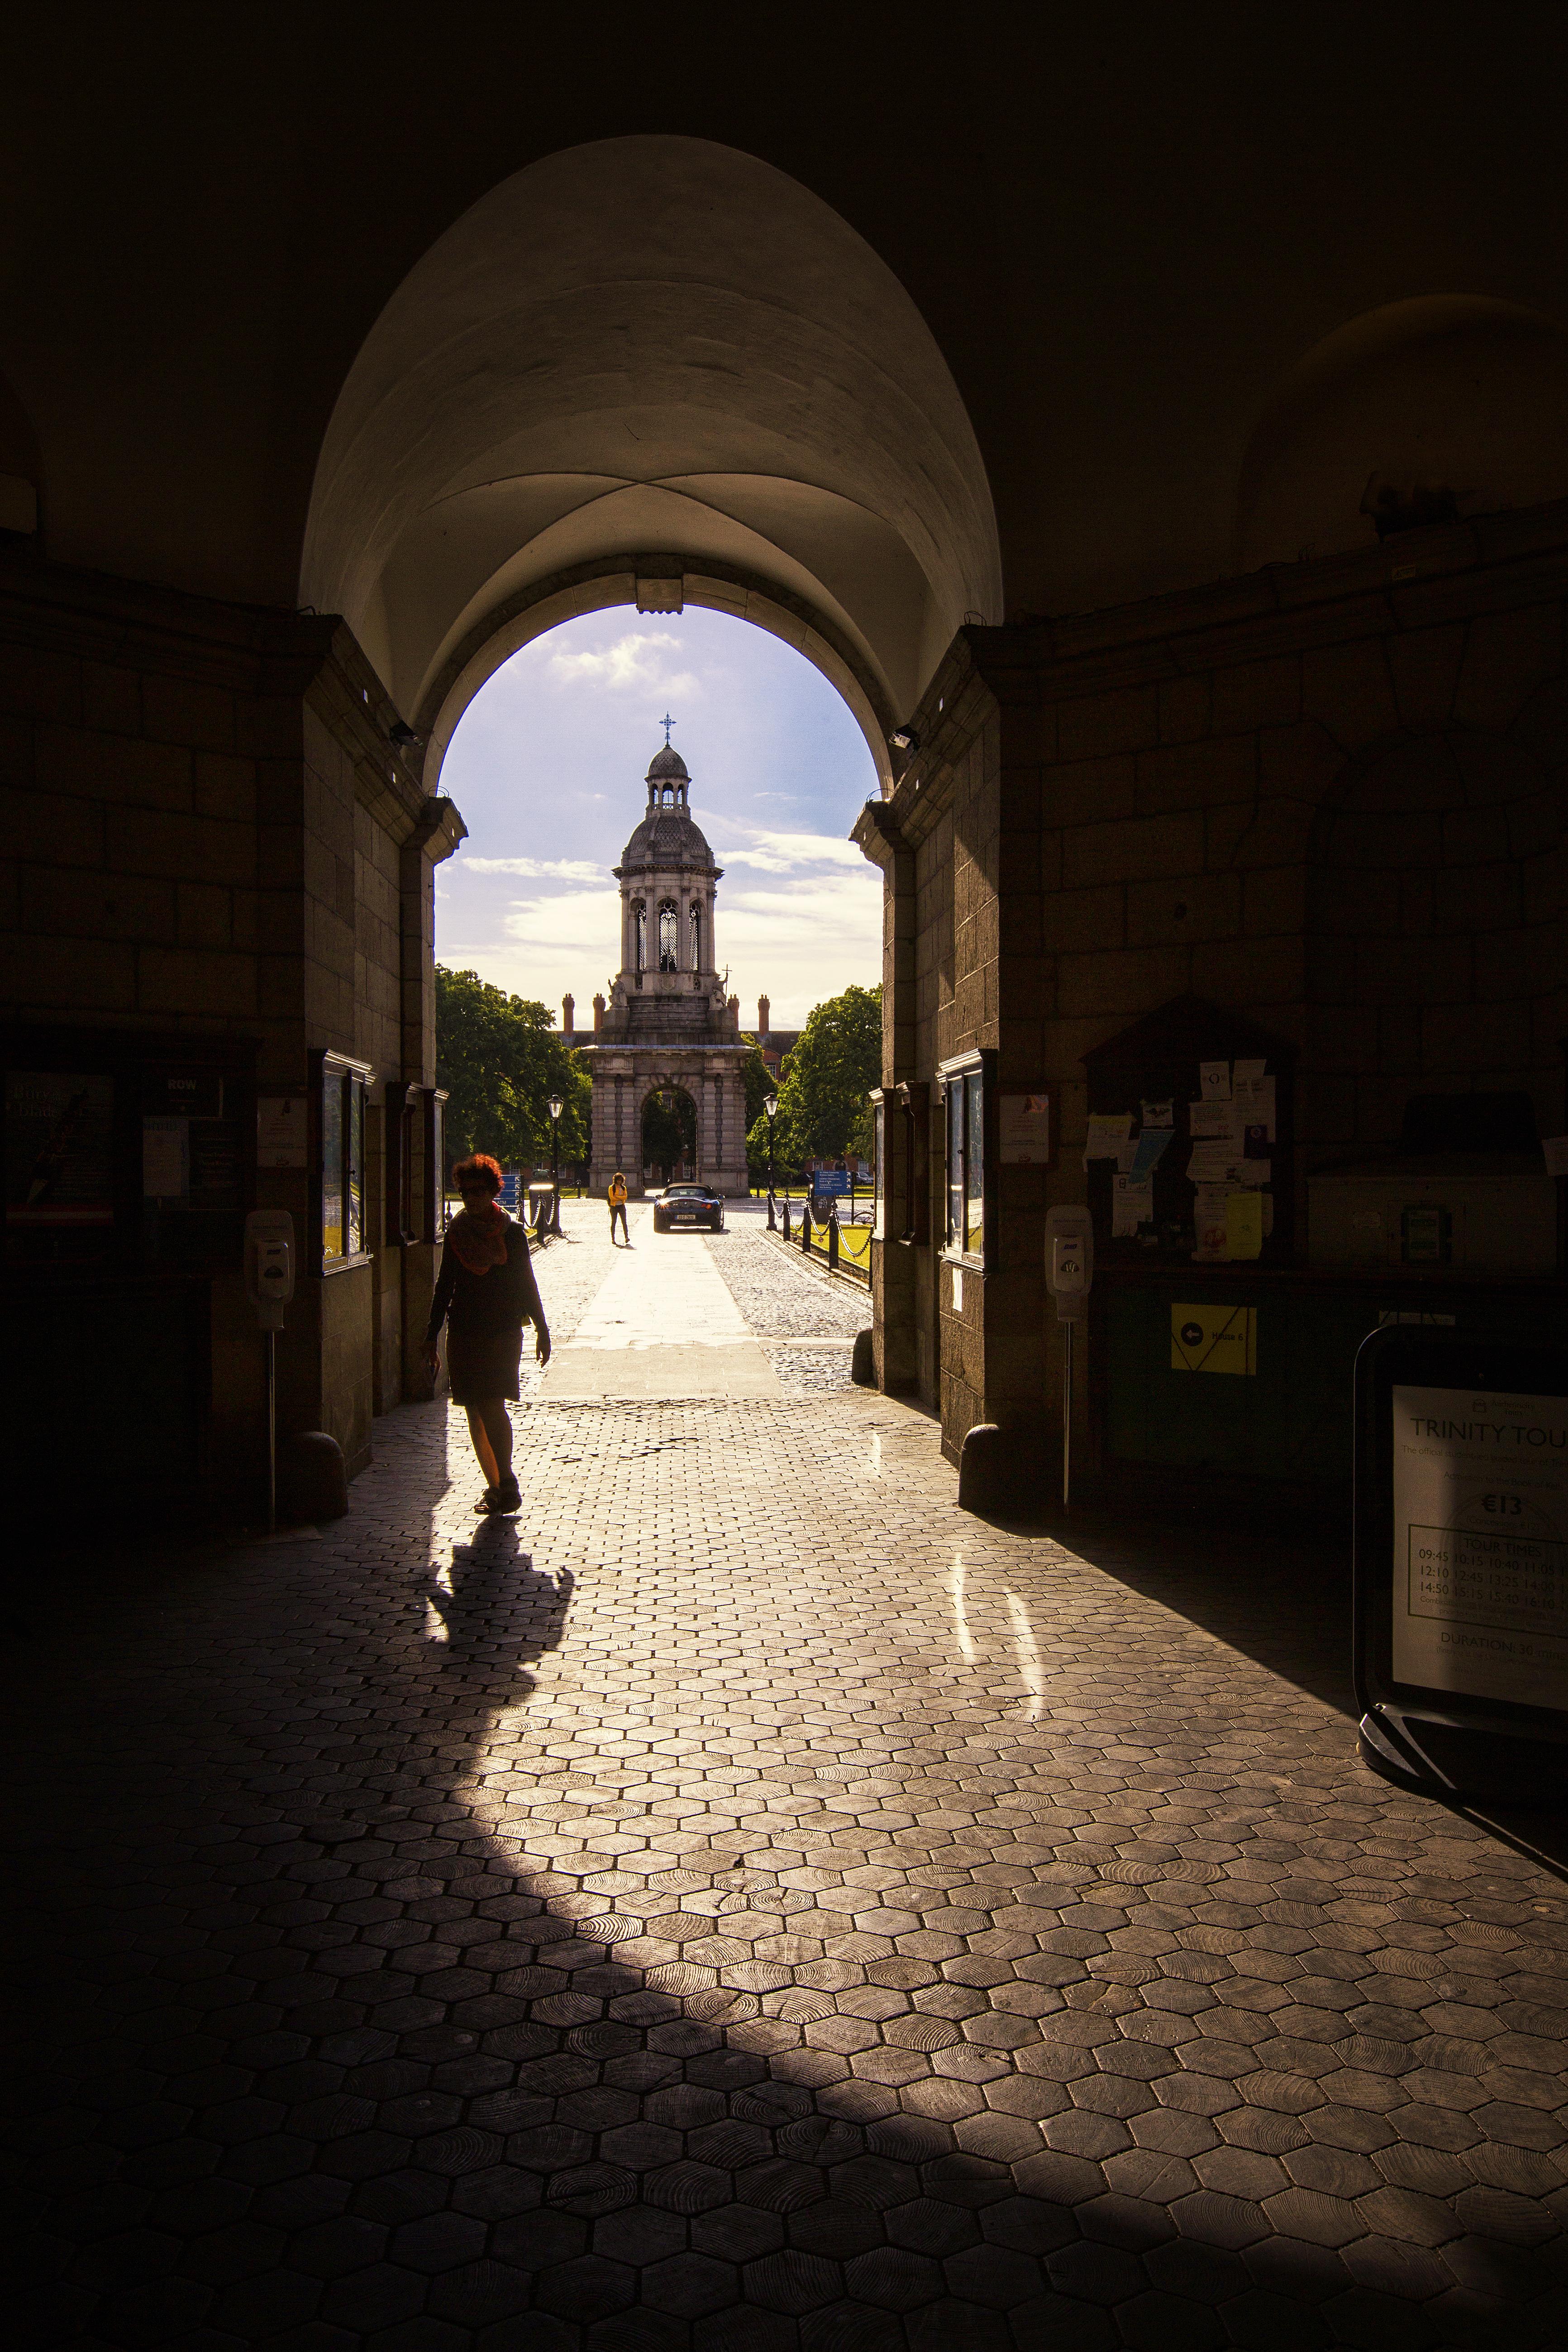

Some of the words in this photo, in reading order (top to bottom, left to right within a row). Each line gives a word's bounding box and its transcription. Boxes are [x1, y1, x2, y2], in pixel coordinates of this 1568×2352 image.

[1212, 1332, 1236, 1341] House
[1411, 1418, 1506, 1443] TRINITY
[1402, 1446, 1416, 1454] The
[1418, 1447, 1443, 1456] official
[1444, 1471, 1483, 1483] Admission
[1495, 1477, 1509, 1485] the
[1511, 1478, 1532, 1488] Book
[1535, 1480, 1546, 1489] of
[1481, 1493, 1522, 1516] €13
[1465, 1538, 1501, 1553] TOUR
[1503, 1543, 1541, 1557] TIMES
[1419, 1549, 1449, 1562] 09:45
[1455, 1554, 1484, 1567] 10:15
[1489, 1558, 1519, 1571] 10:40
[1525, 1563, 1555, 1576] 11:05
[1420, 1565, 1449, 1579] 12:10
[1455, 1570, 1484, 1583] 12:45
[1489, 1574, 1519, 1588] 13:25
[1525, 1579, 1555, 1593] 14:00
[1420, 1582, 1449, 1595] 14:50
[1455, 1586, 1484, 1600] 15:15
[1489, 1590, 1519, 1604] 15:40
[1525, 1598, 1555, 1610] 16:10
[1441, 1632, 1516, 1653] DURATION:
[1519, 1644, 1534, 1655] 30
[1538, 1649, 1567, 1661] mins
